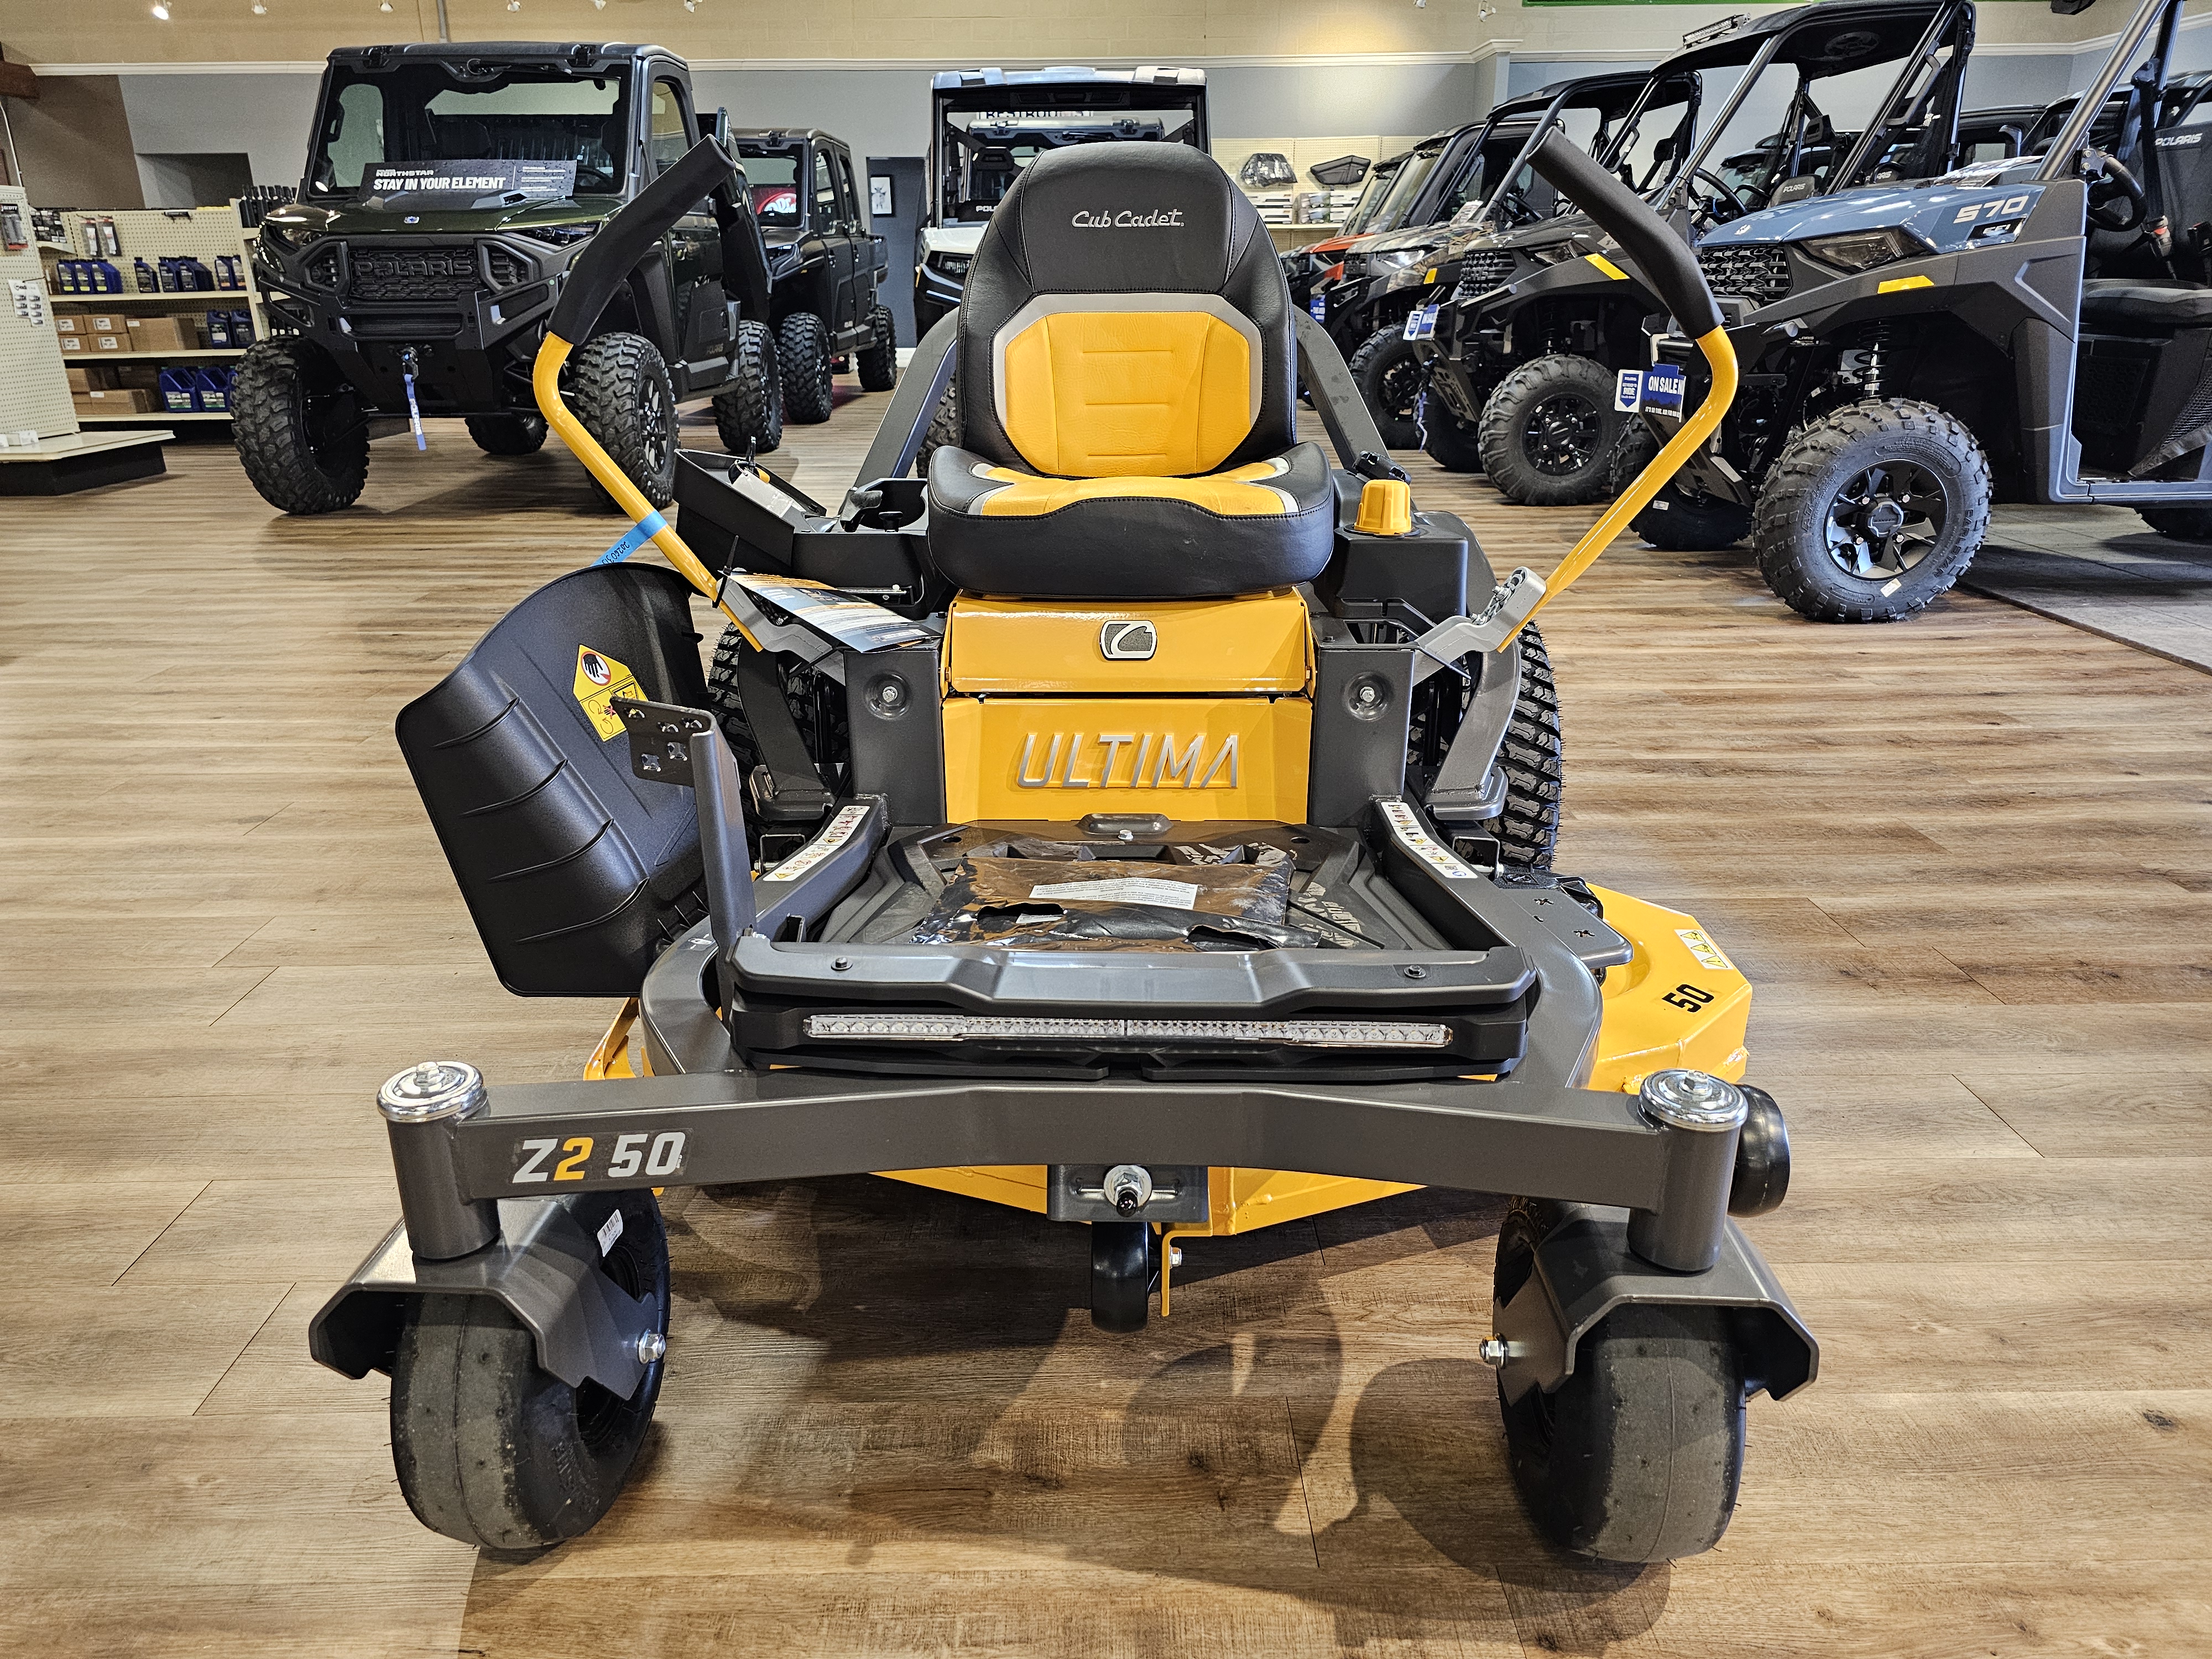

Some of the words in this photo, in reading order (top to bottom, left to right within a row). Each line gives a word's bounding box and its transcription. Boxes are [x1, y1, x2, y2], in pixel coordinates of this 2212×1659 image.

[2154, 133, 2203, 147] POLARIS
[373, 179, 404, 190] STAY
[404, 178, 418, 190] IN
[420, 177, 450, 190] YOUR
[451, 176, 507, 189] ELEMENT
[1783, 183, 1806, 192] POLARIS
[1071, 210, 1112, 228] Cub
[1114, 208, 1183, 228] Cadet
[1953, 195, 2029, 223] 570
[354, 260, 473, 276] POLARIS
[1623, 387, 1636, 395] RIDE
[1648, 375, 1659, 392] ON
[1660, 377, 1678, 394] SALE
[409, 398, 422, 435] POLARIS
[1016, 732, 1239, 789] ULTIMA
[1661, 984, 1715, 1013] 50
[512, 1136, 594, 1183] Z2
[608, 1131, 686, 1177] 50
